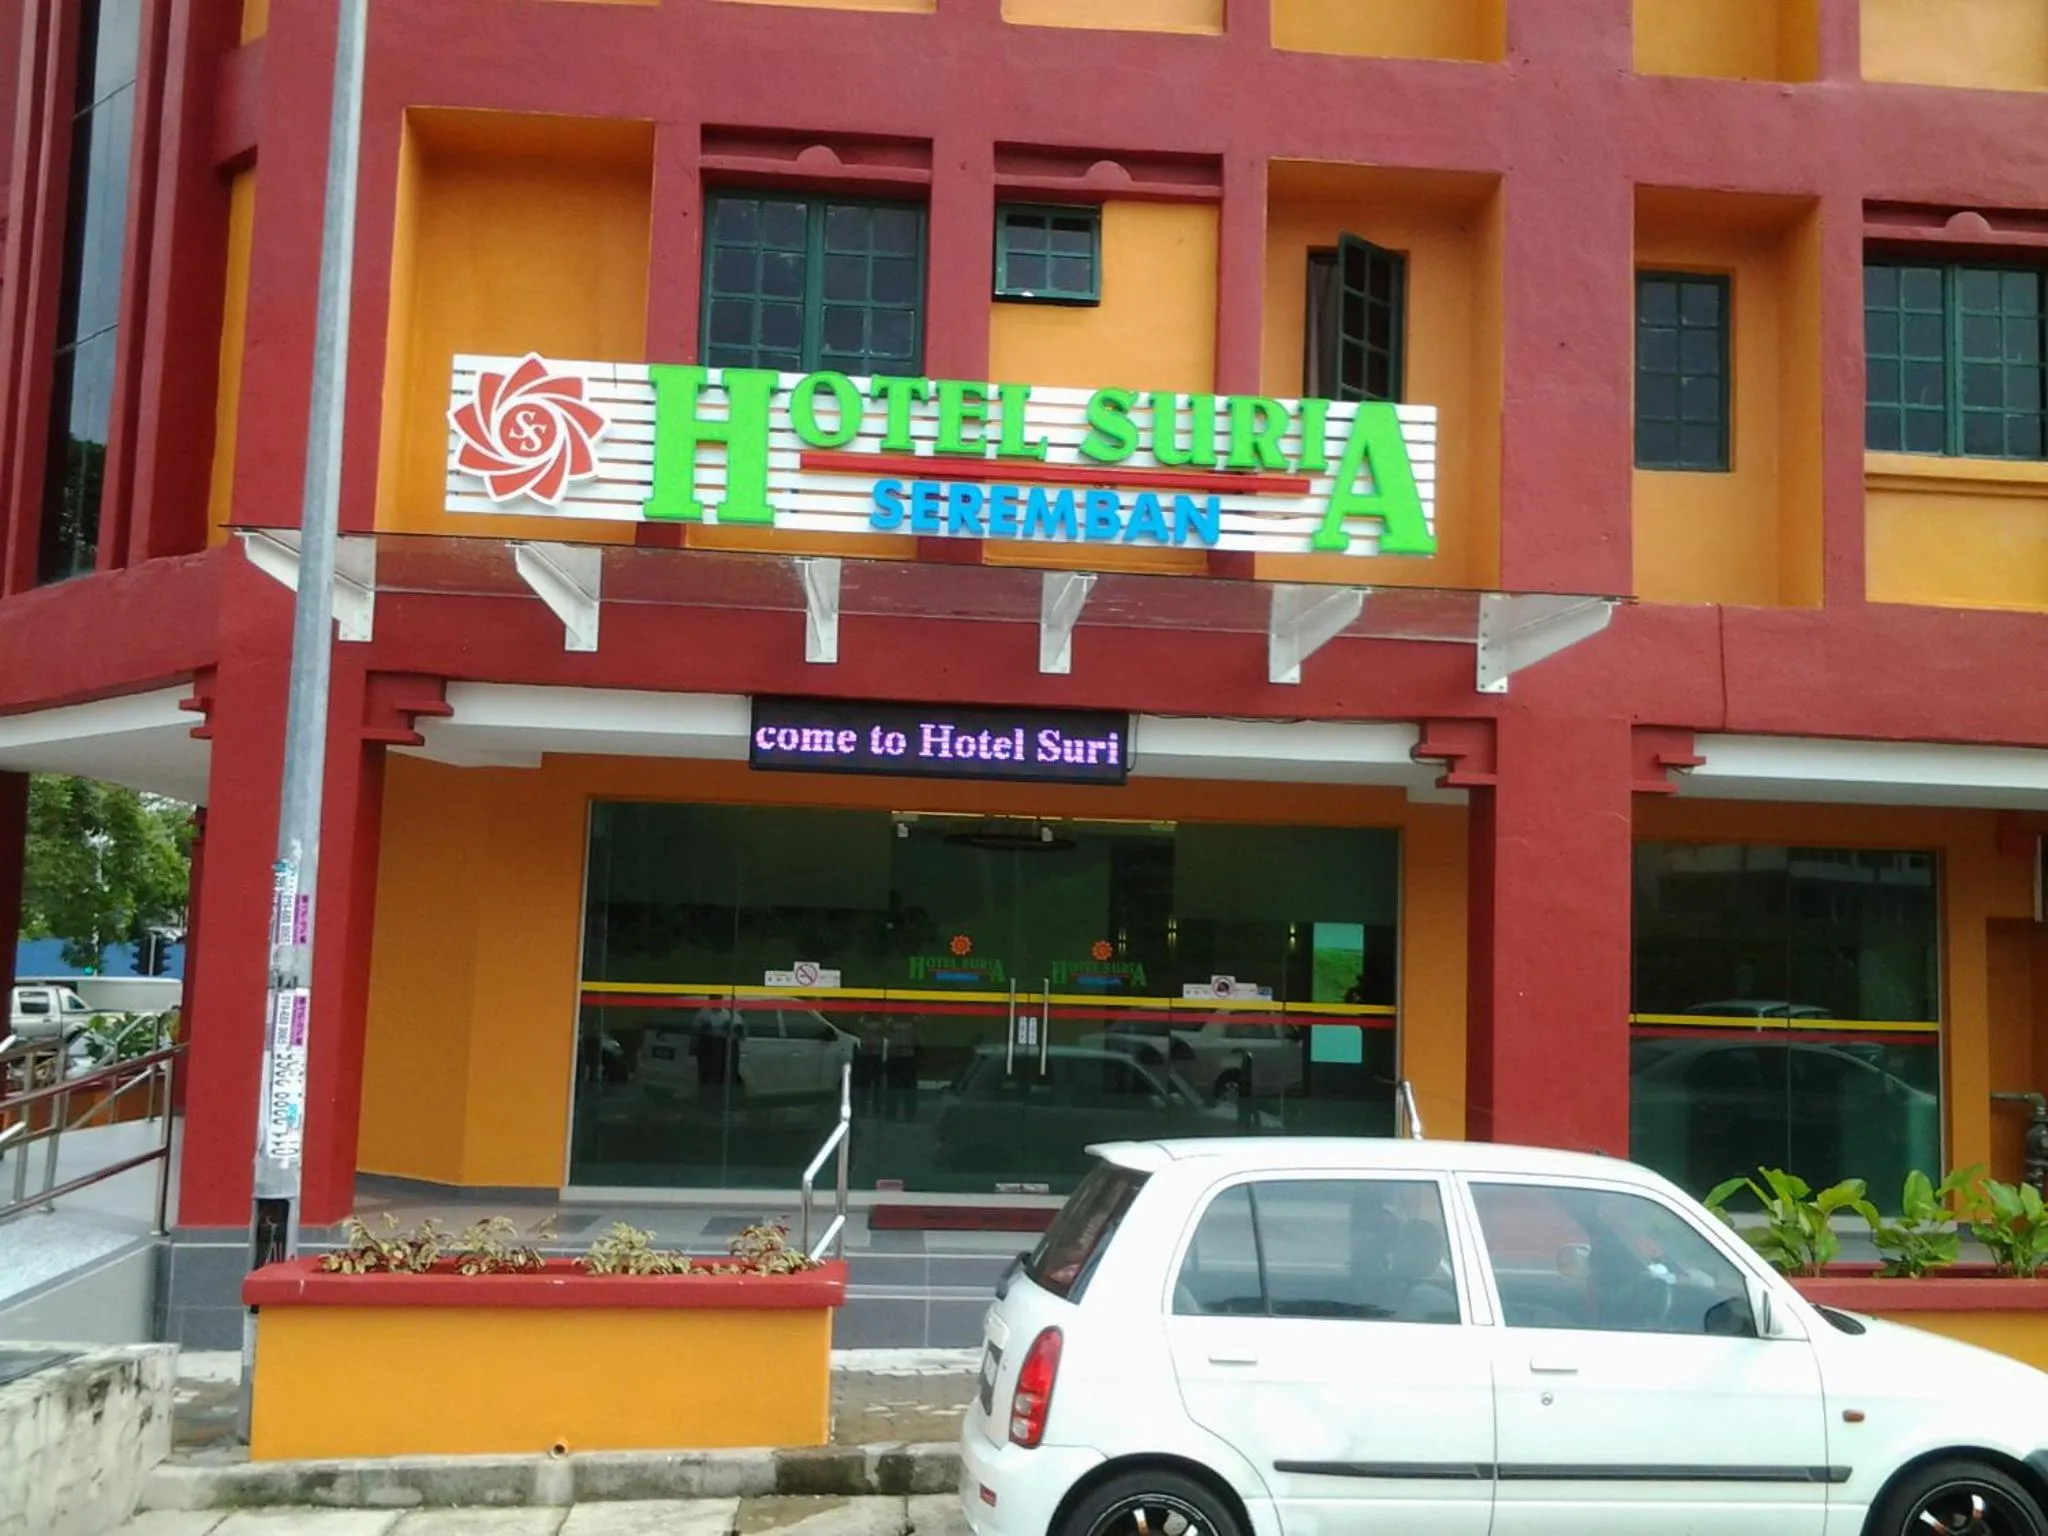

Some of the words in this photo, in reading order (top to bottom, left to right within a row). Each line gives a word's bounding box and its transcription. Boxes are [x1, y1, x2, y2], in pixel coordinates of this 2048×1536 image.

[643, 365, 1049, 524] HOTEL
[1079, 388, 1437, 555] SURIA
[869, 479, 1222, 546] SEREMBAN
[755, 725, 858, 755] come
[869, 725, 908, 756] to
[918, 723, 1026, 762] Hotel
[1036, 728, 1121, 765] Suri
